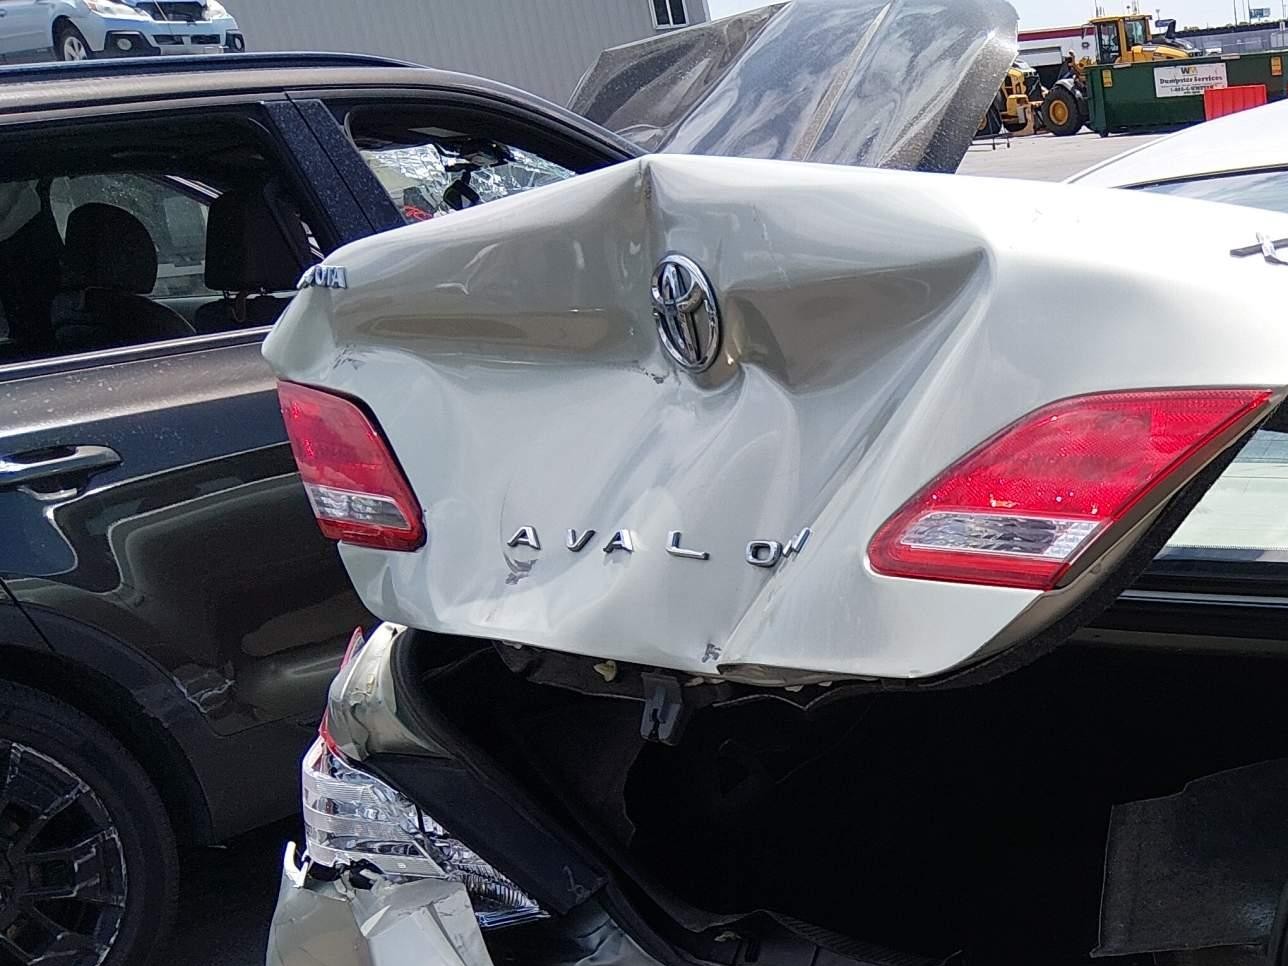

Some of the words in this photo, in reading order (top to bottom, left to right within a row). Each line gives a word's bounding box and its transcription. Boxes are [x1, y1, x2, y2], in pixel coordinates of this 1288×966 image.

[1160, 77, 1193, 85] Dumpster
[1194, 75, 1223, 83] Services
[506, 525, 812, 568] AVALON
